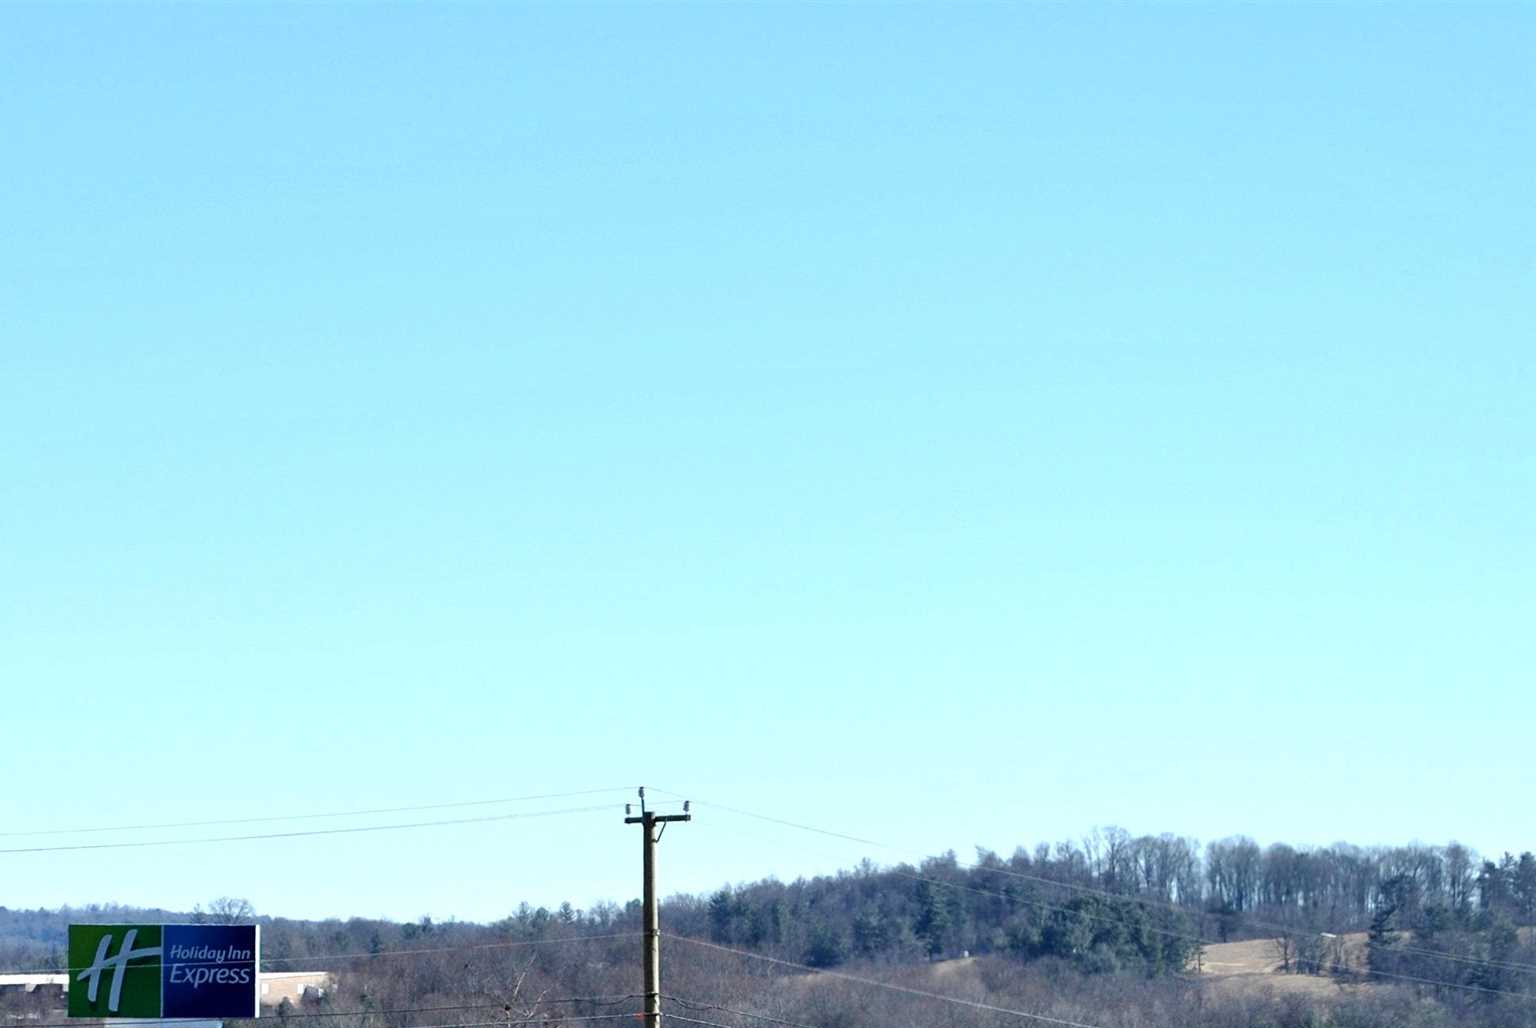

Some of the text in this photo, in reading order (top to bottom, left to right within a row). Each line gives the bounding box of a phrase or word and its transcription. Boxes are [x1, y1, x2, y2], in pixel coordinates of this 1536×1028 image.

[170, 945, 251, 964] Holiday Inn
[169, 964, 251, 989] Express
